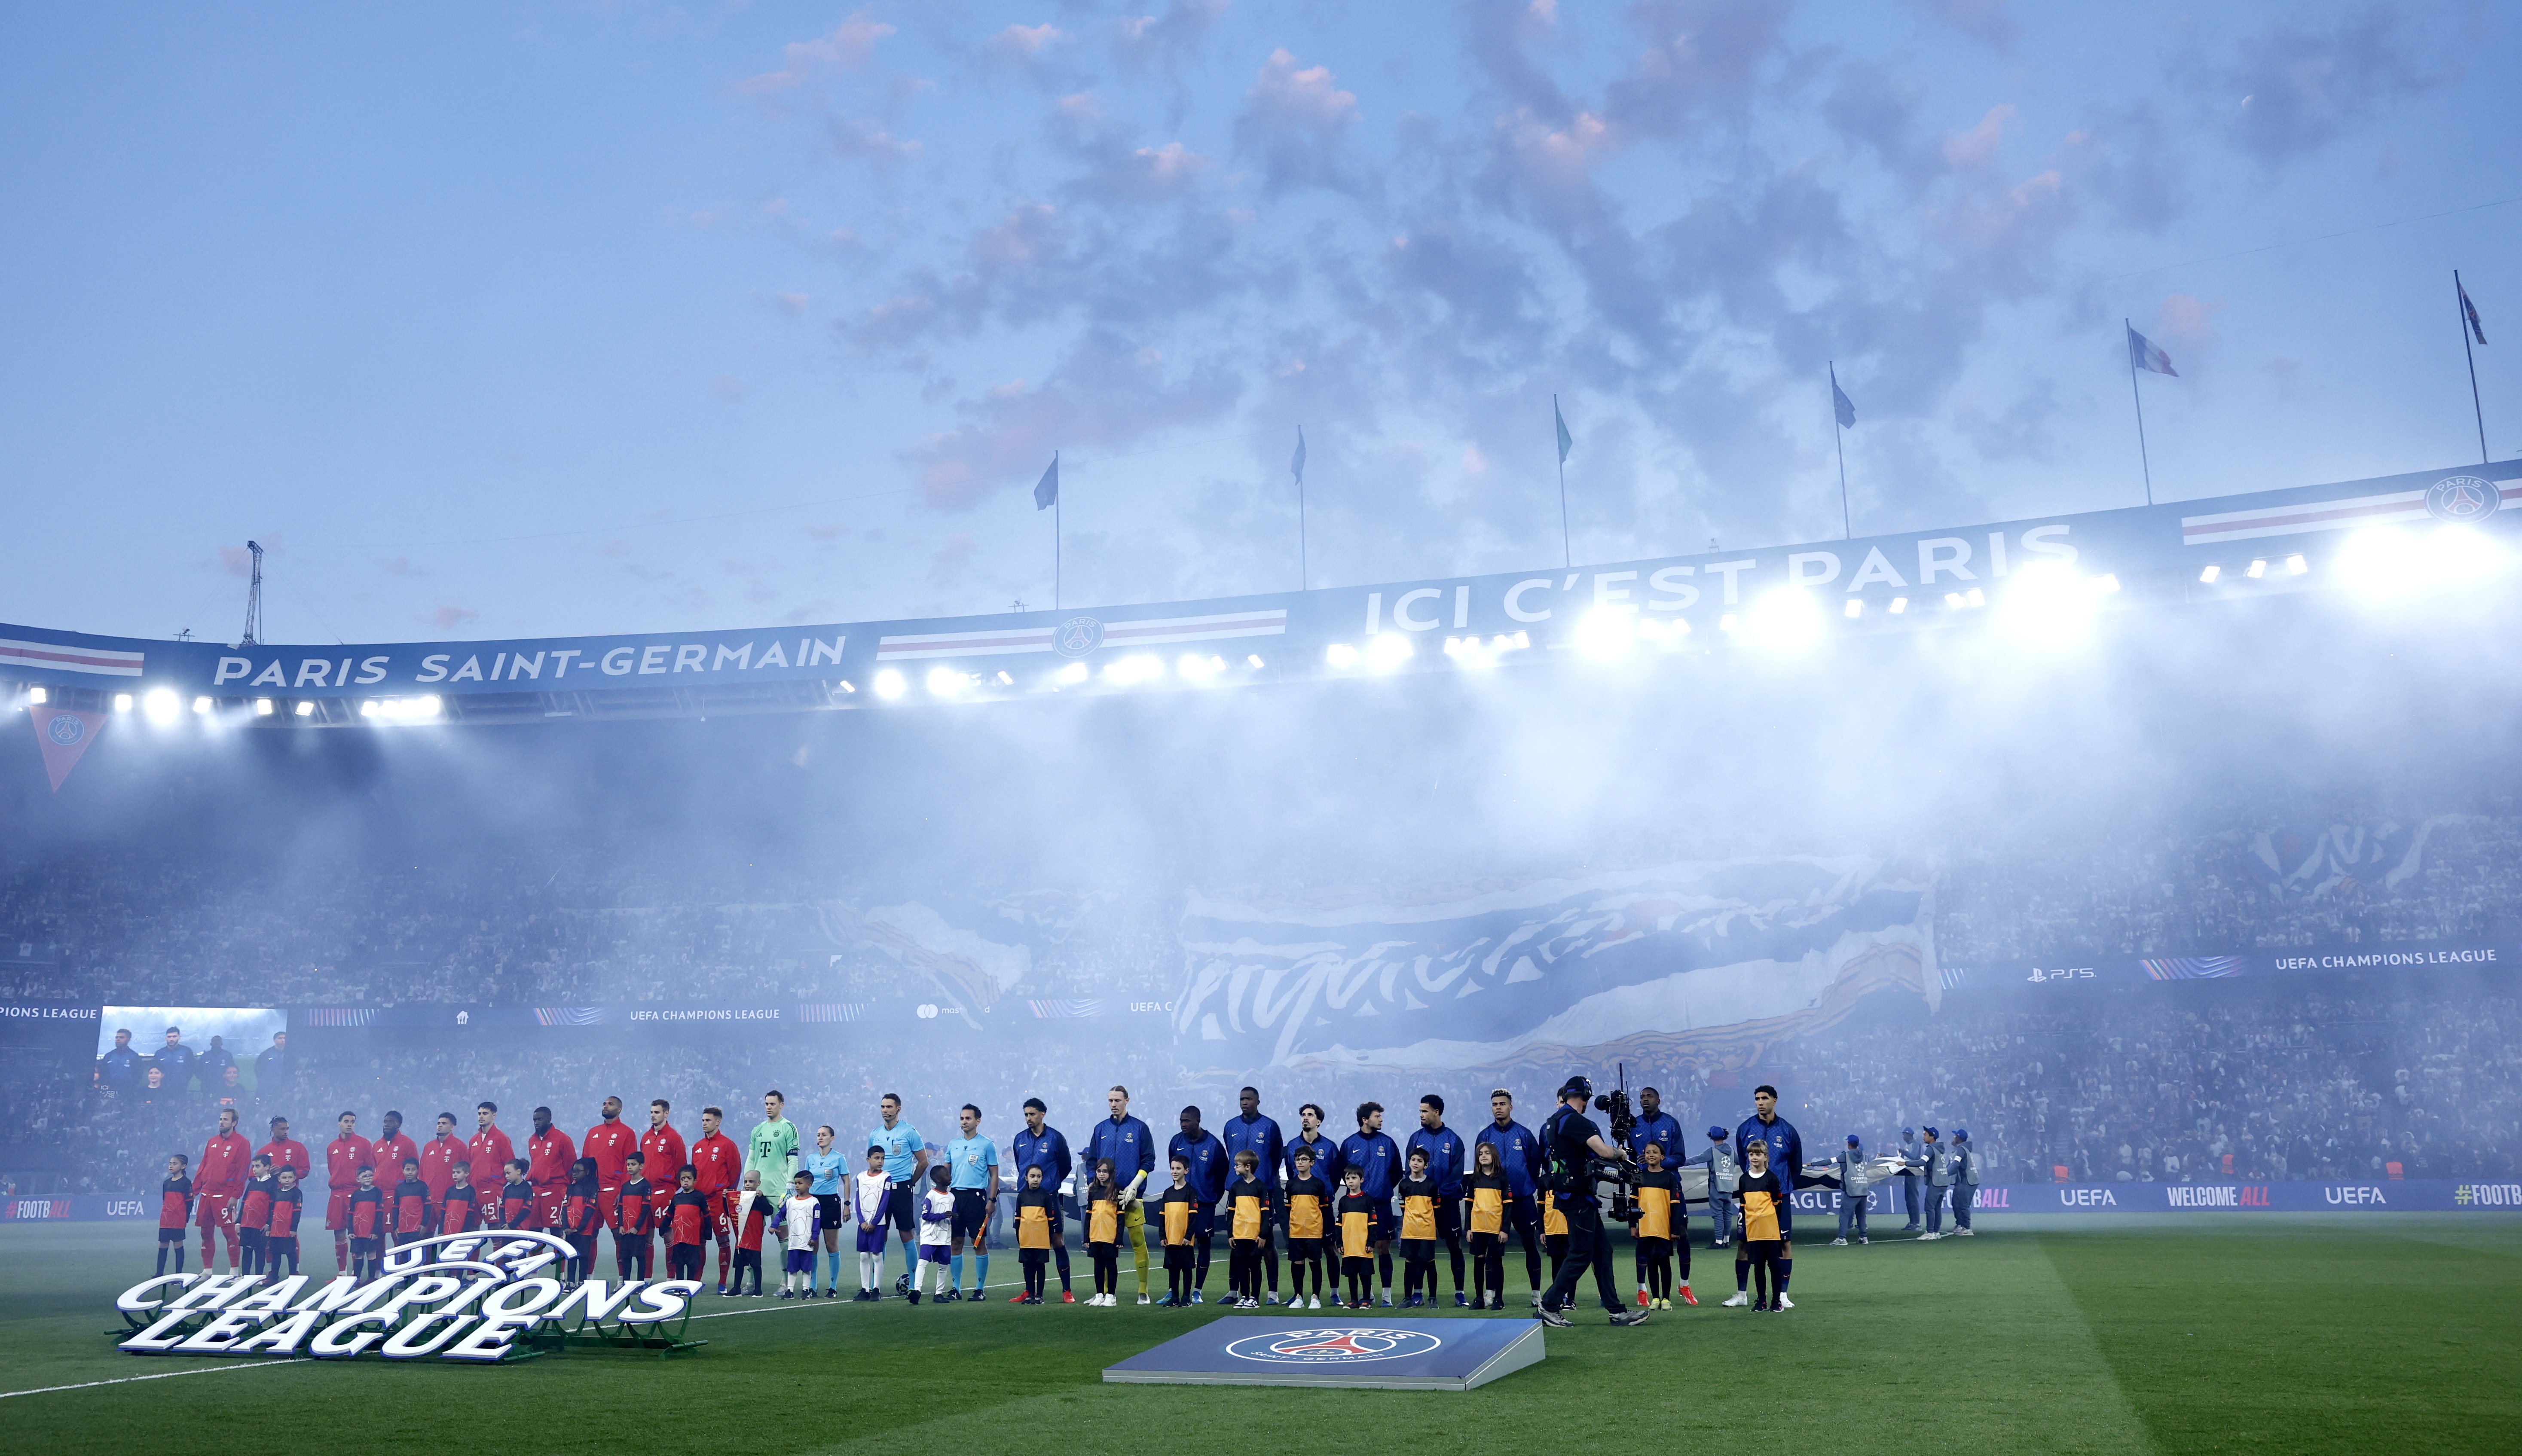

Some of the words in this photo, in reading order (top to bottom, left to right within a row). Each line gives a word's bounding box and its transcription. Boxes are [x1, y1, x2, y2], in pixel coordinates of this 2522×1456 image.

[2436, 478, 2482, 491] PARIS
[1365, 586, 1469, 635] ICI
[1503, 559, 1756, 623] C'EST
[1788, 524, 2079, 593] PARIS
[1064, 618, 1096, 629] PARIS
[214, 656, 389, 687] PARIS
[415, 636, 846, 683] SAINT-GERMAIN
[2276, 958, 2318, 970] UEFA
[2322, 952, 2424, 969] CHAMPIONS
[2429, 949, 2497, 964] LEAGUE
[2050, 968, 2094, 980] PS5
[43, 1008, 97, 1019] LEAGUE
[1131, 1001, 1161, 1012] UEFA
[630, 1010, 659, 1021] UEFA
[662, 1010, 731, 1020] CHAMPIONS
[735, 1009, 780, 1020] LEAGUE
[760, 1141, 771, 1157] T
[2060, 1190, 2117, 1206] UEFA
[2167, 1187, 2238, 1206] WELCOME
[2239, 1187, 2270, 1206] ALL
[2325, 1187, 2387, 1204] UEFA
[4, 1200, 71, 1219] #FOOTBALL
[107, 1201, 144, 1216] UEFA
[221, 1208, 228, 1219] 9
[482, 1203, 495, 1220] 45
[550, 1206, 557, 1218] 2
[719, 1213, 726, 1225] 6
[1738, 1212, 1742, 1225] 2
[382, 1237, 559, 1279] UEFA
[116, 1273, 705, 1322] CHAMPIONS
[117, 1309, 542, 1360] LEAGUE
[1285, 1330, 1416, 1340] PARIS
